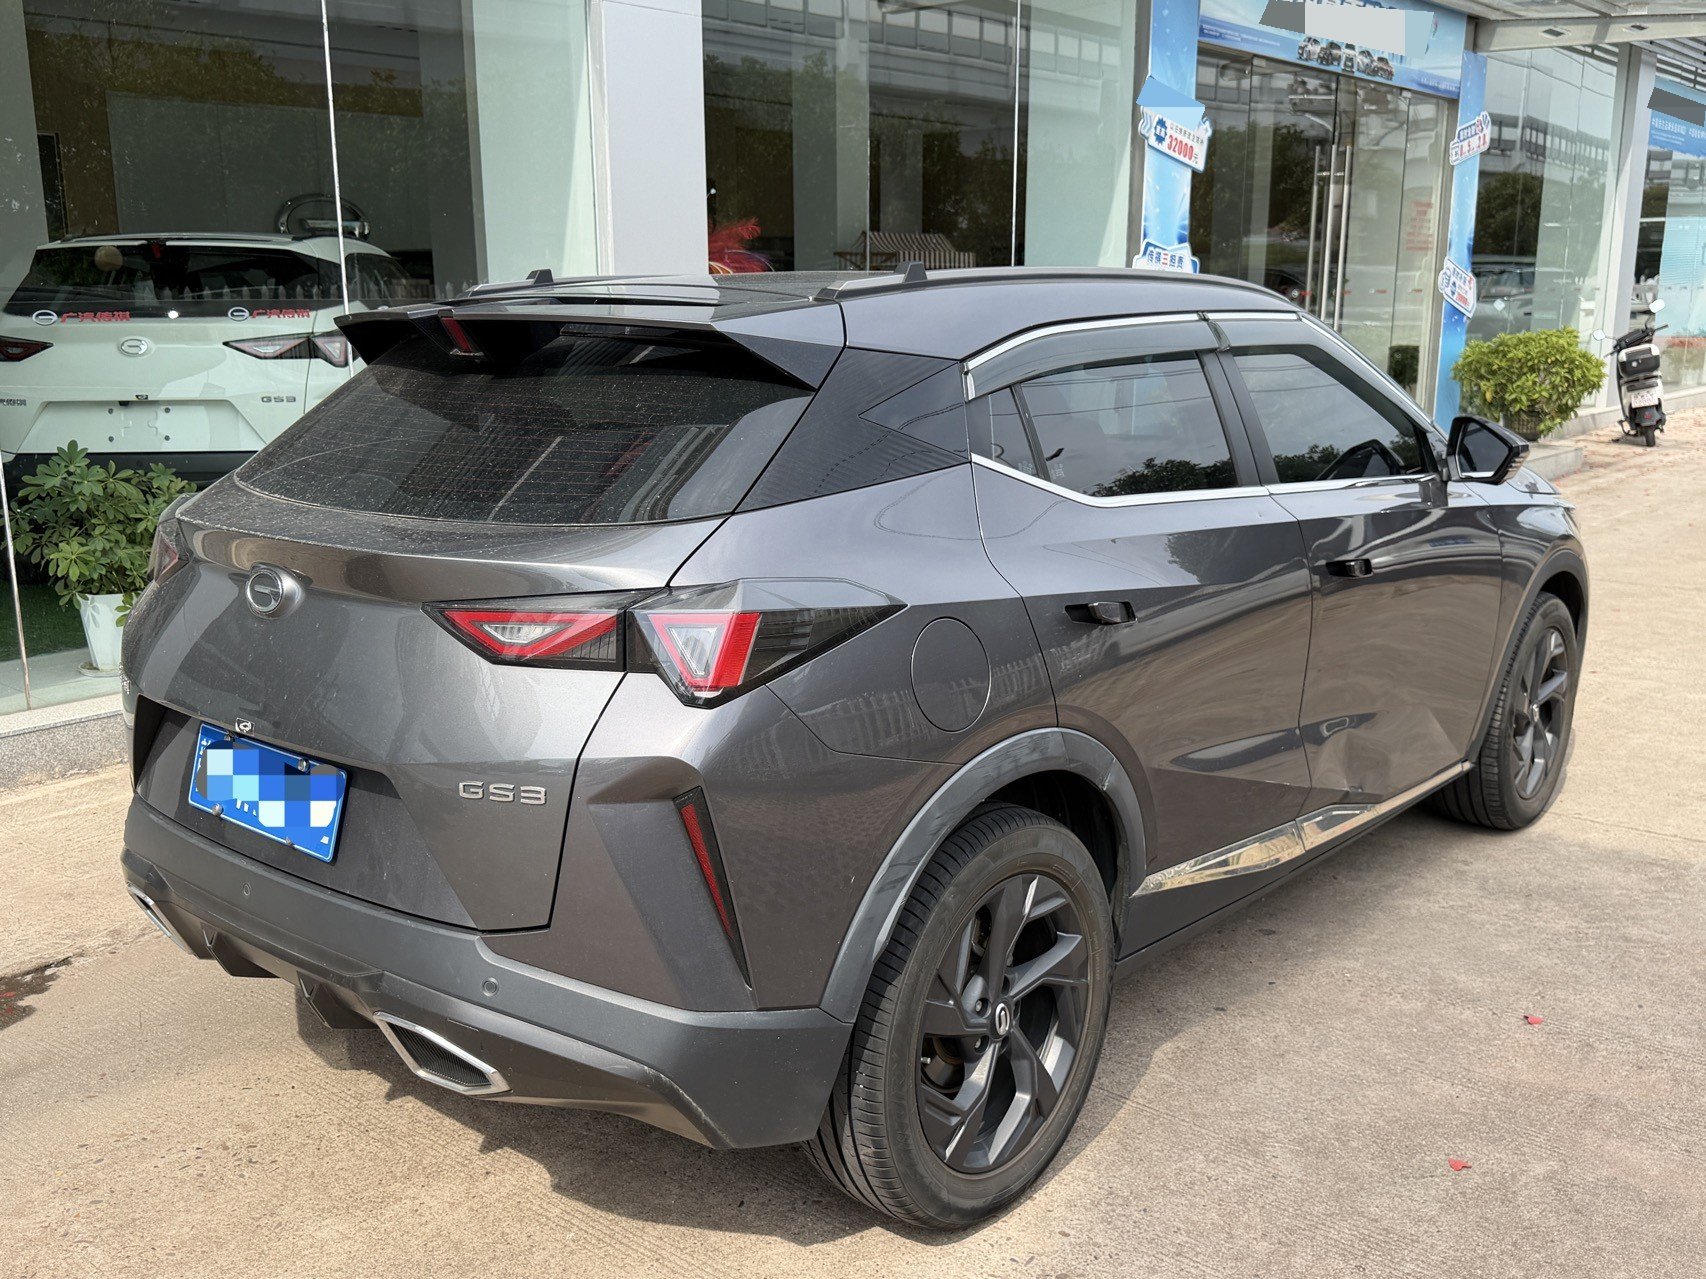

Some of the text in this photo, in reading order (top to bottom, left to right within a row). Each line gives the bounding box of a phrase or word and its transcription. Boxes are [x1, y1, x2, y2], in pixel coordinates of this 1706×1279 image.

[60, 310, 132, 324] 广汽传祺
[252, 308, 311, 319] 广汽传祺
[261, 395, 296, 403] GS3
[458, 780, 547, 806] GS3
